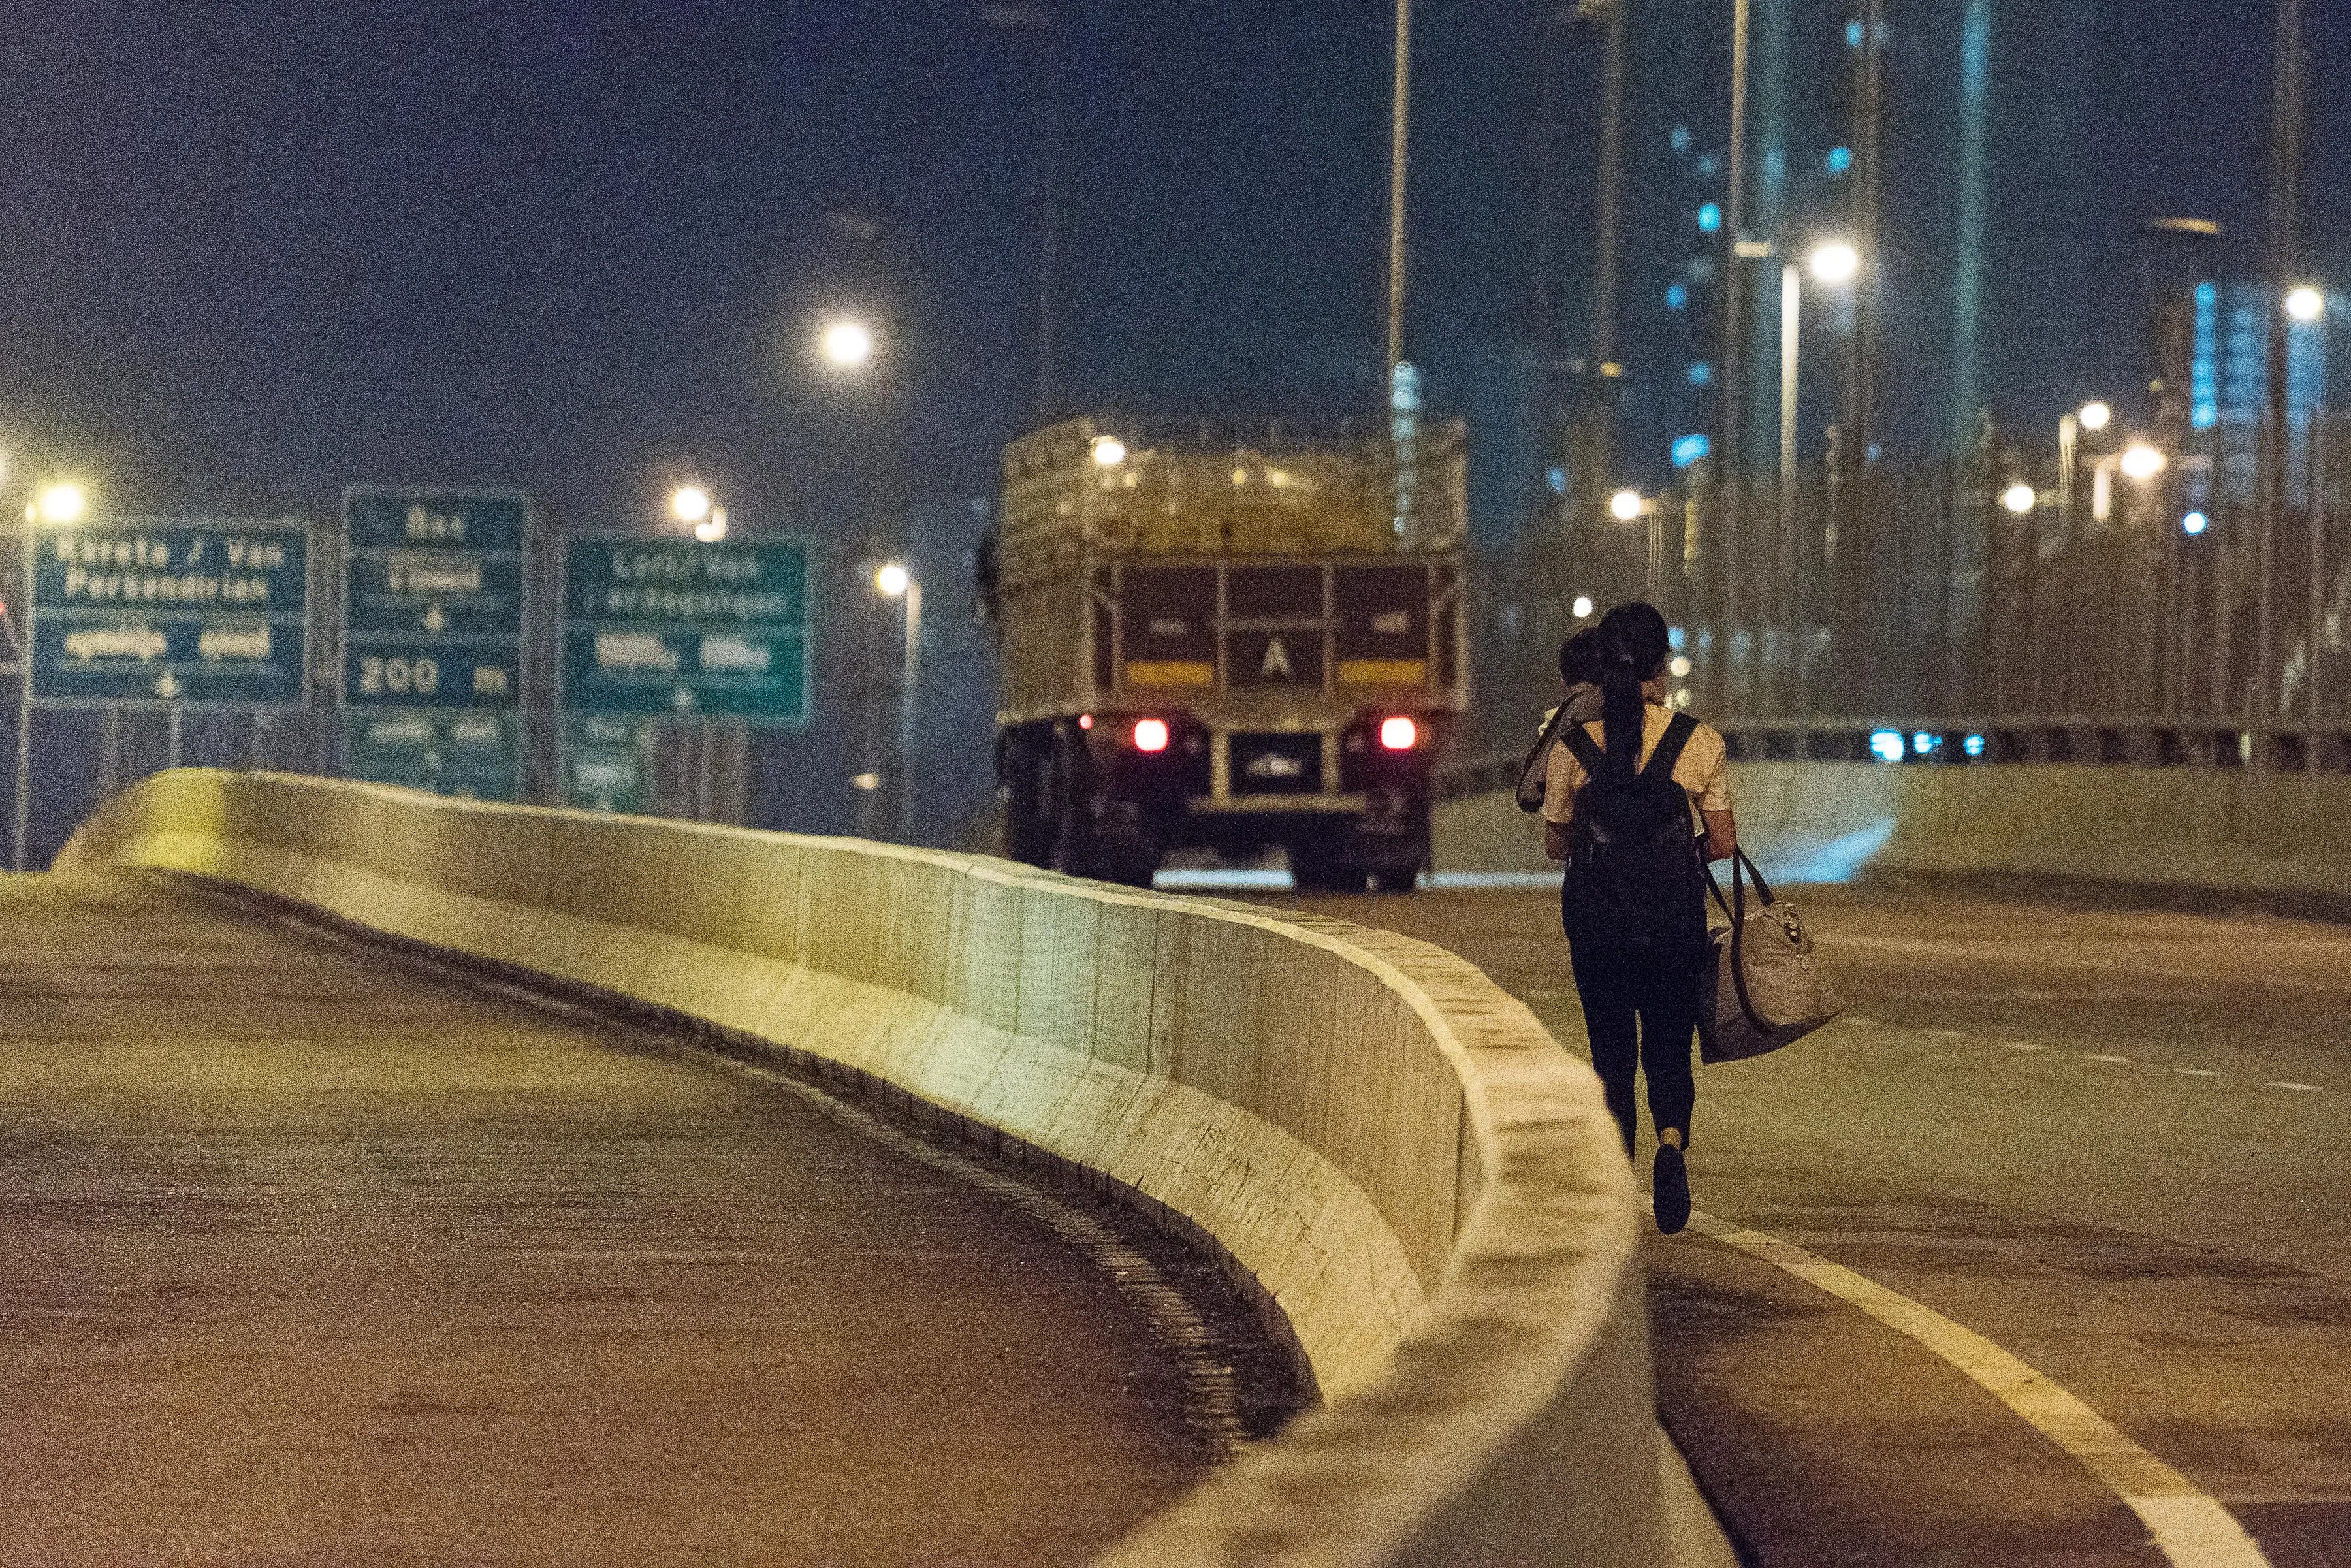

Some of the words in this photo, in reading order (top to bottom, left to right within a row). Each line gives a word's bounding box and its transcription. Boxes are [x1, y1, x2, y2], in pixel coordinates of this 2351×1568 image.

[225, 537, 285, 569] Van
[360, 656, 440, 694] 200
[473, 666, 507, 694] m
